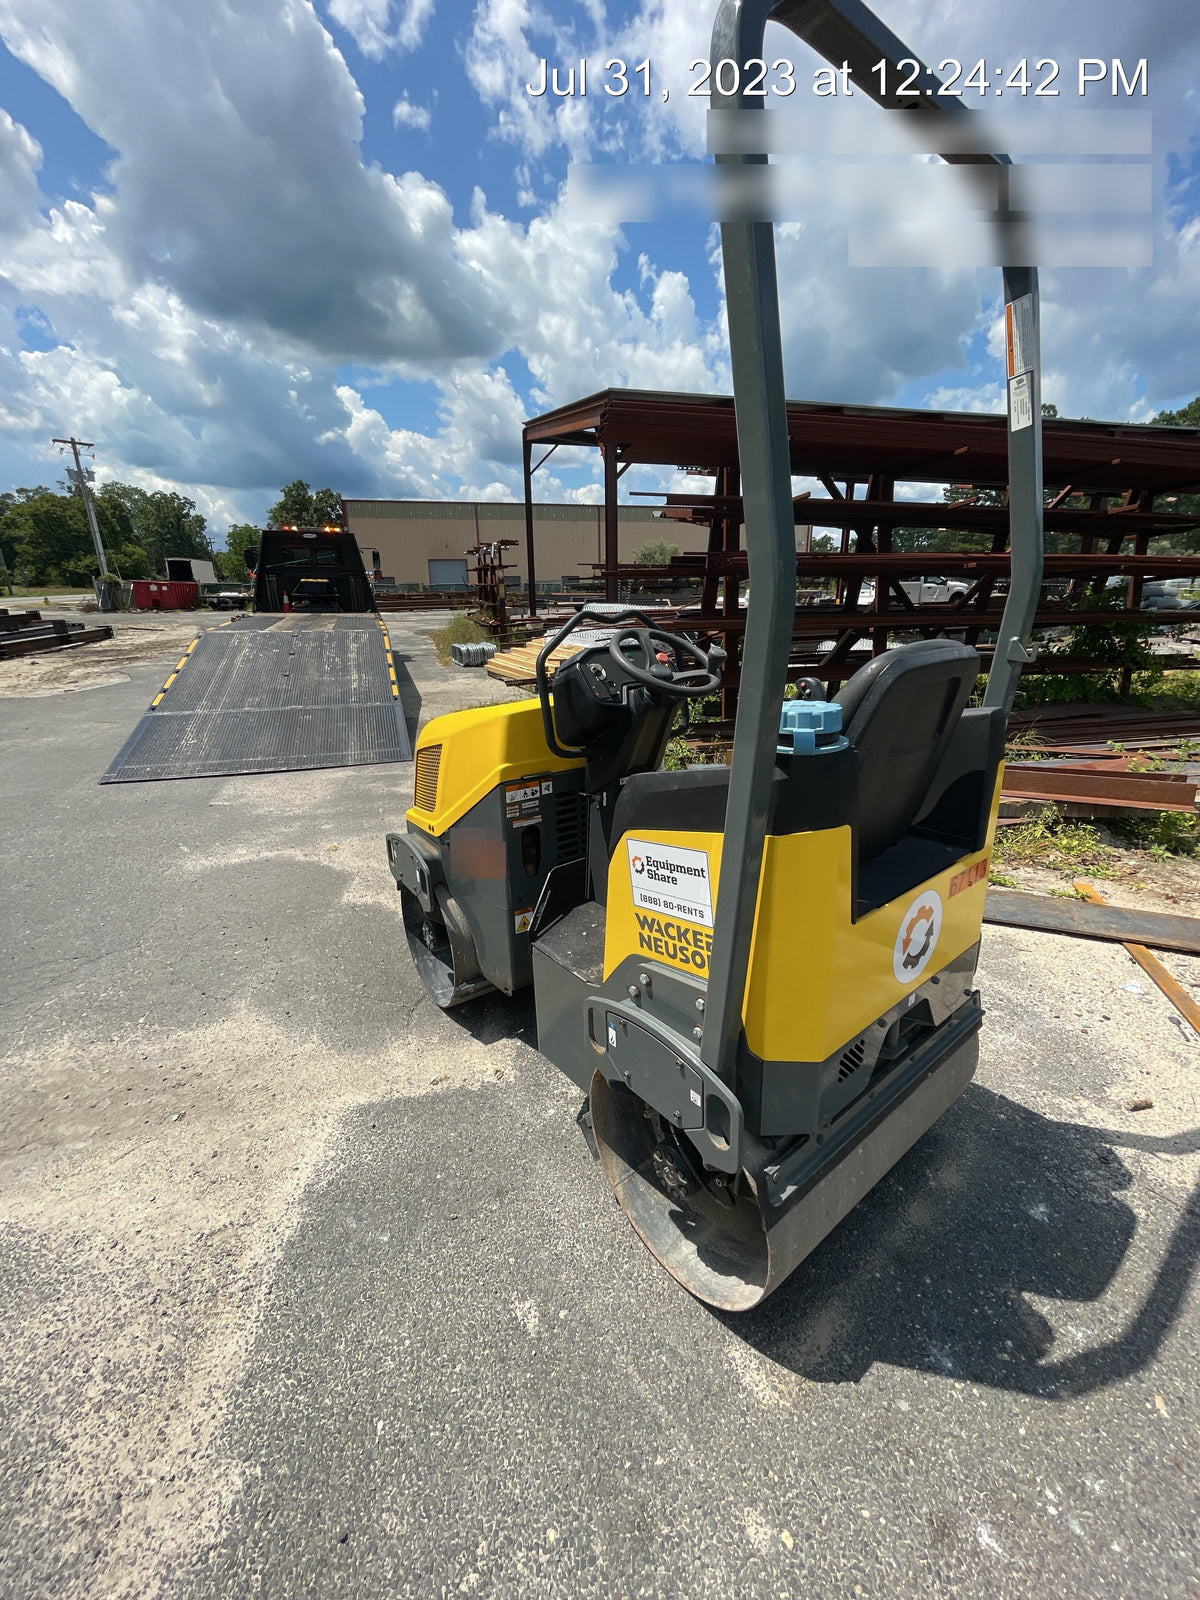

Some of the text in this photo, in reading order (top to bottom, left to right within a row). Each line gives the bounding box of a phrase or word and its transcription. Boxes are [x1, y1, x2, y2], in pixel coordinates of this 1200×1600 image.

[645, 856, 706, 878] Equipment
[647, 869, 678, 885] Share
[640, 893, 705, 919] (888) 80-RENTS
